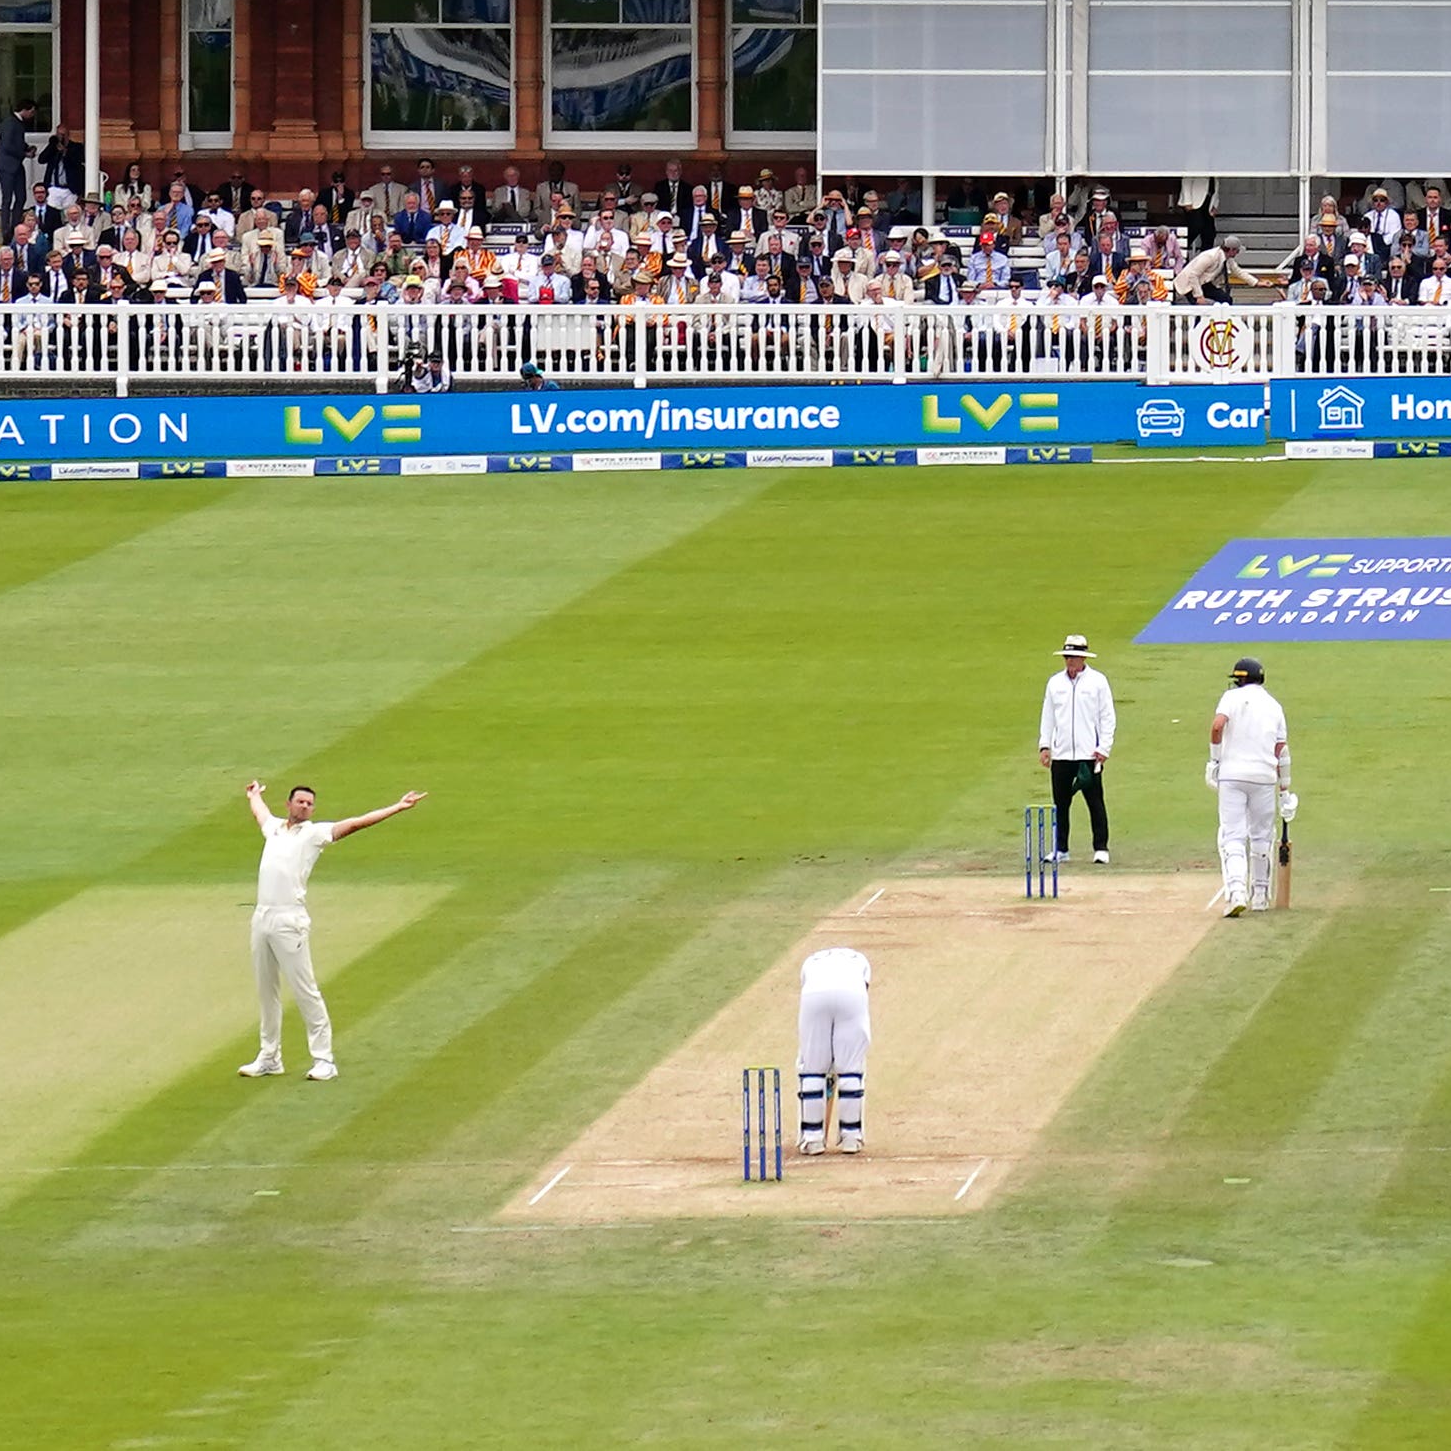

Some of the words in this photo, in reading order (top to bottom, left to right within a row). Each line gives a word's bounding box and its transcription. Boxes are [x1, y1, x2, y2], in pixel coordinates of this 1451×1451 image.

[512, 400, 839, 438] LV.com/insurance
[1207, 401, 1264, 428] Car
[1173, 589, 1289, 610] RUTH
[1213, 609, 1421, 625] FOUNDATION
